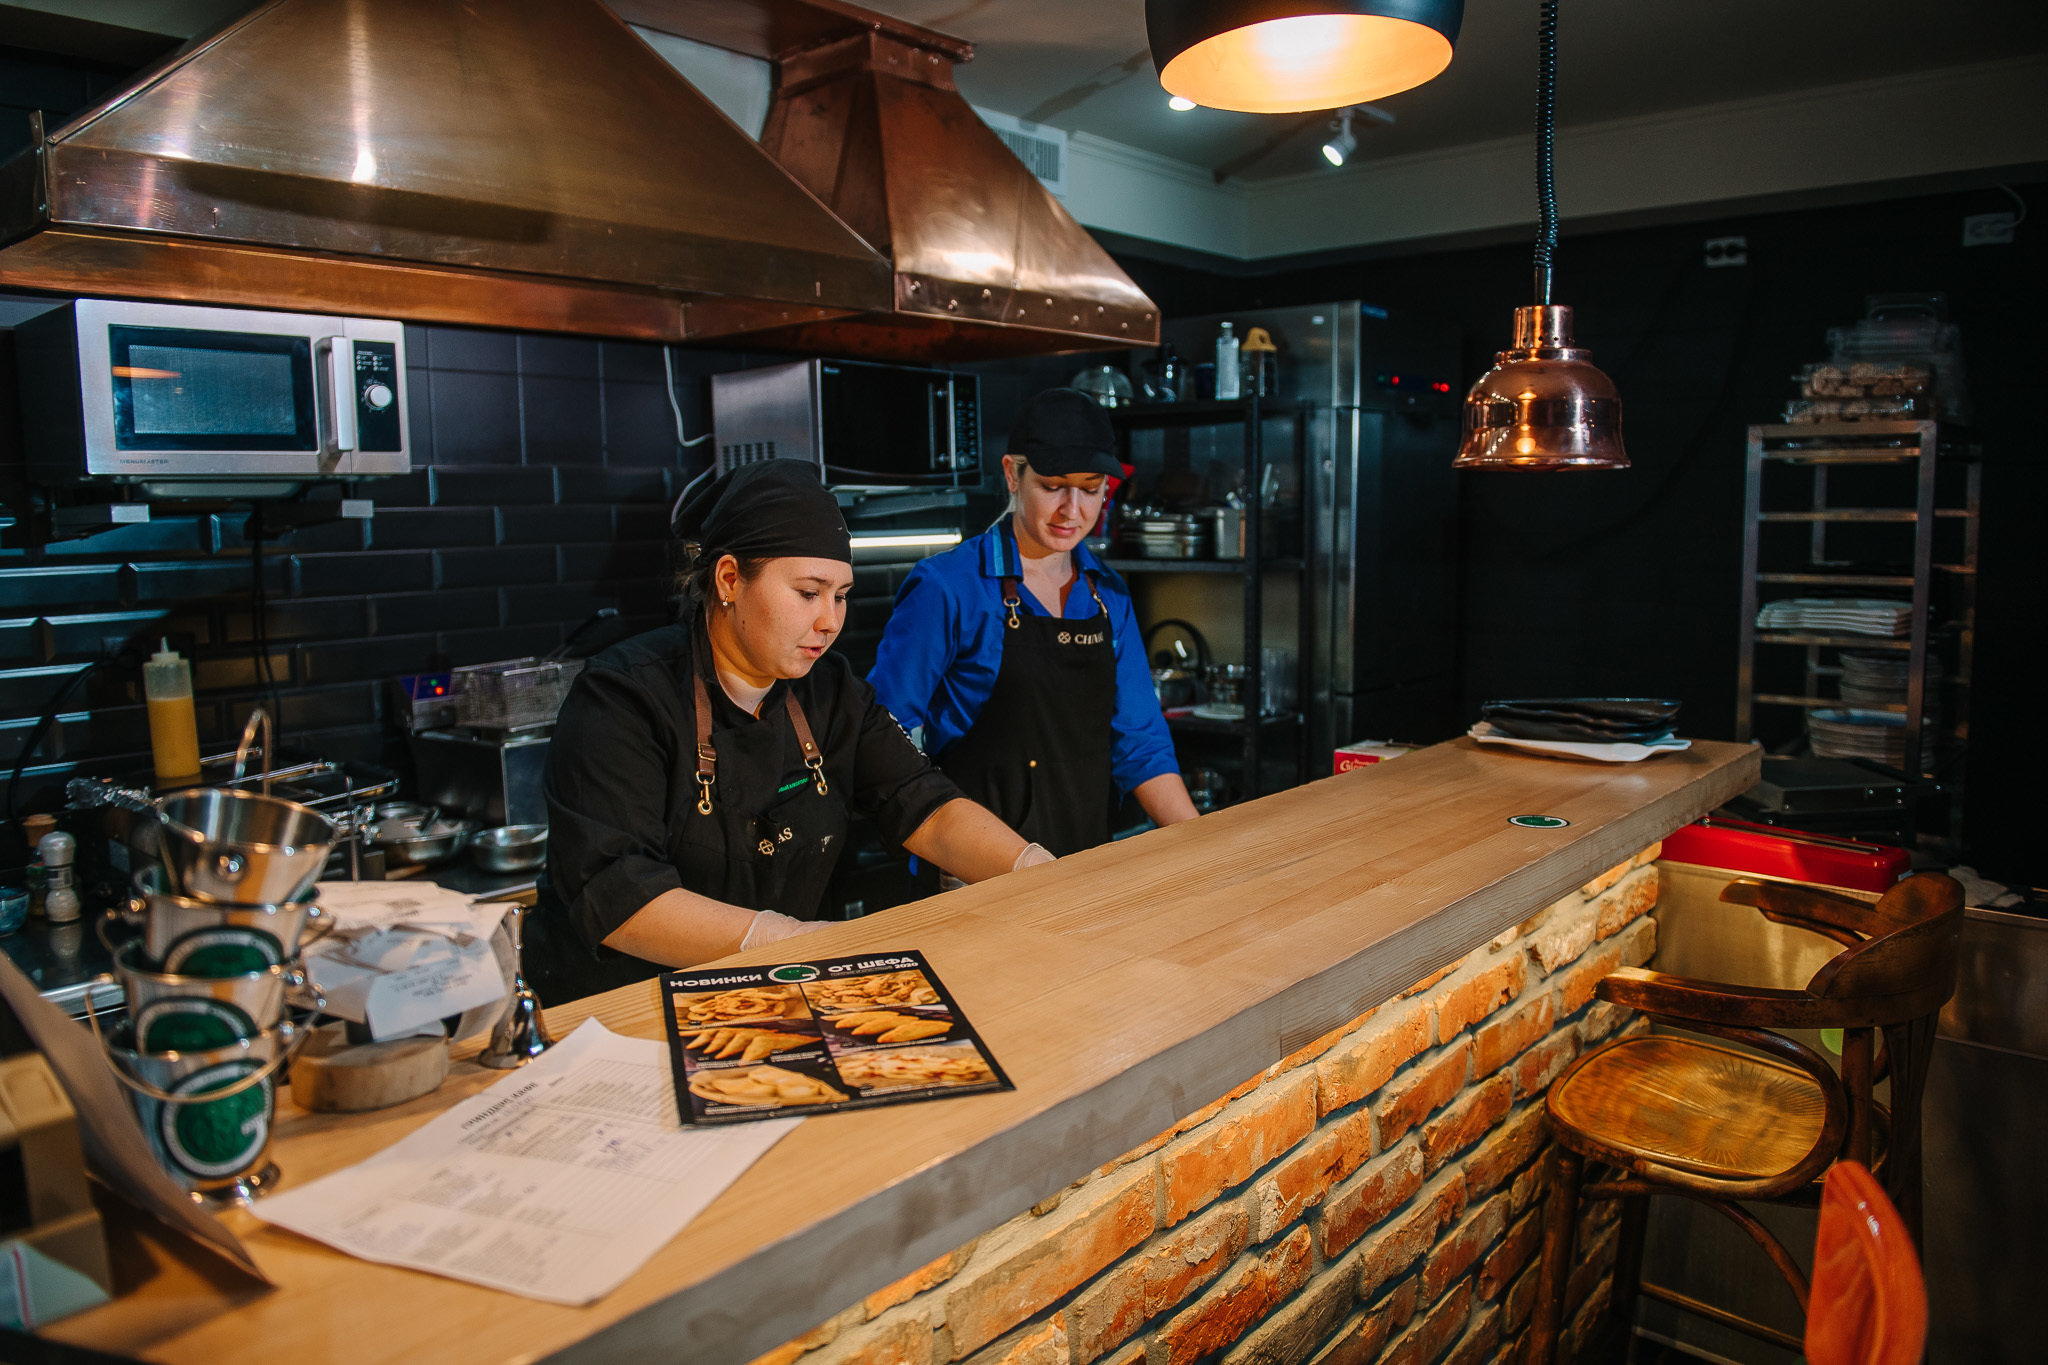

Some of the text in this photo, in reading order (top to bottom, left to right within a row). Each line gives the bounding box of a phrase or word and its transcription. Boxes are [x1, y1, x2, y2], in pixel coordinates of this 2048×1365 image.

[669, 973, 763, 987] НОВИНКИ
[827, 963, 854, 973] ОТ
[857, 956, 915, 970] ШЕФА
[894, 961, 919, 970] 2020
